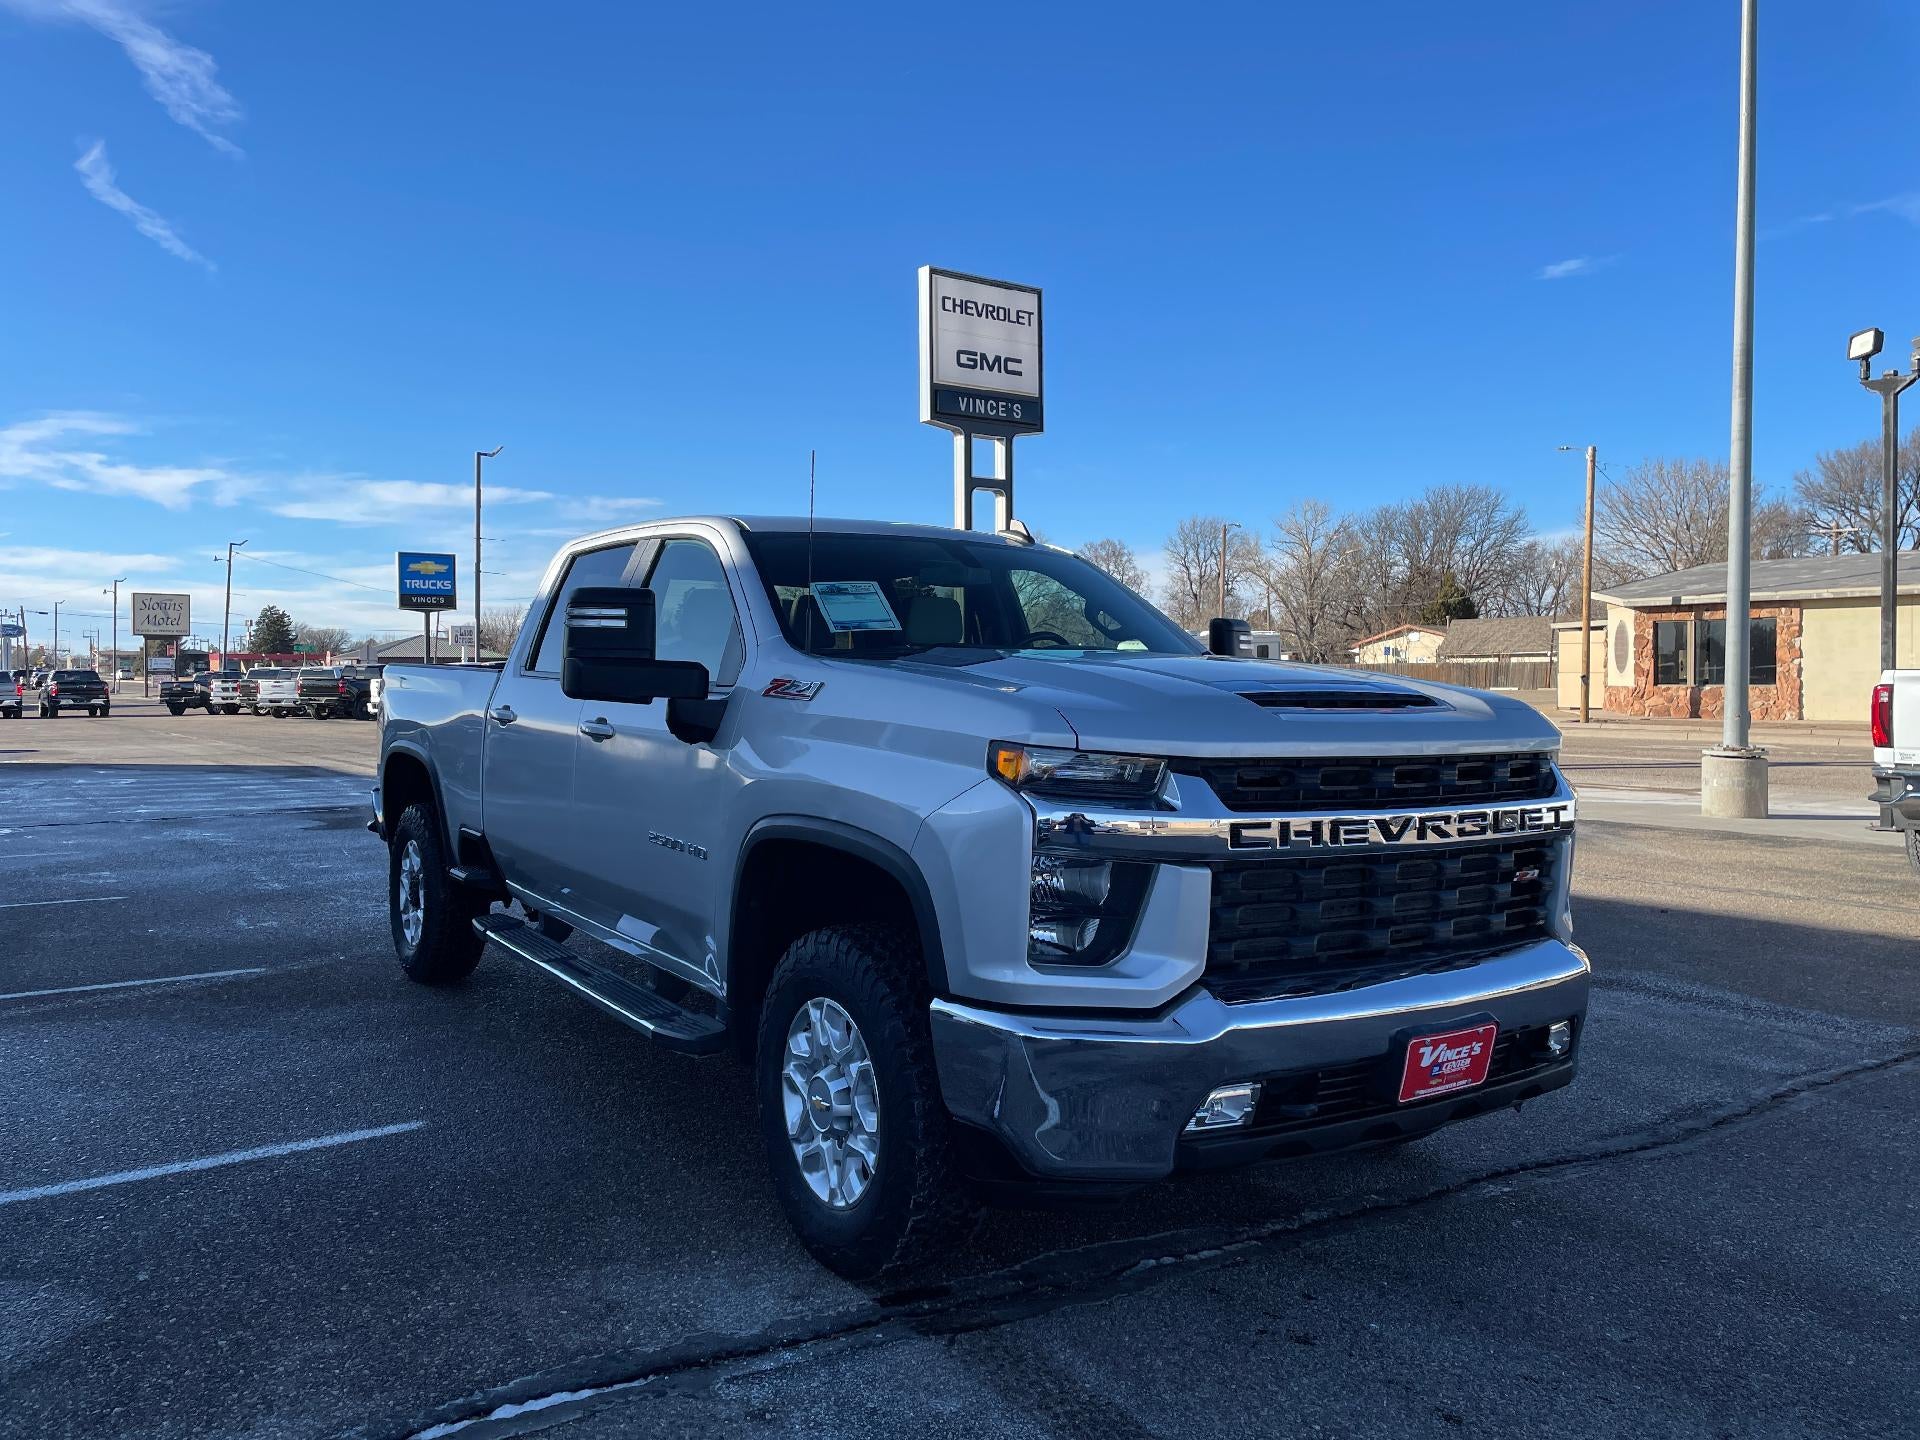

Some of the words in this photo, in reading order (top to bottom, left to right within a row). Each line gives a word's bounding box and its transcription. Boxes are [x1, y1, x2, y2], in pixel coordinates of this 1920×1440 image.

[941, 295, 1034, 326] CHEVROLET
[956, 349, 1023, 377] GMC
[958, 396, 1022, 419] VINCE'S
[404, 579, 452, 590] TRUCKS
[139, 597, 184, 612] Sloans
[411, 596, 445, 604] VINCE'S
[140, 612, 182, 626] Motel
[760, 678, 824, 702] Z71
[1229, 805, 1568, 850] CHEVROLET
